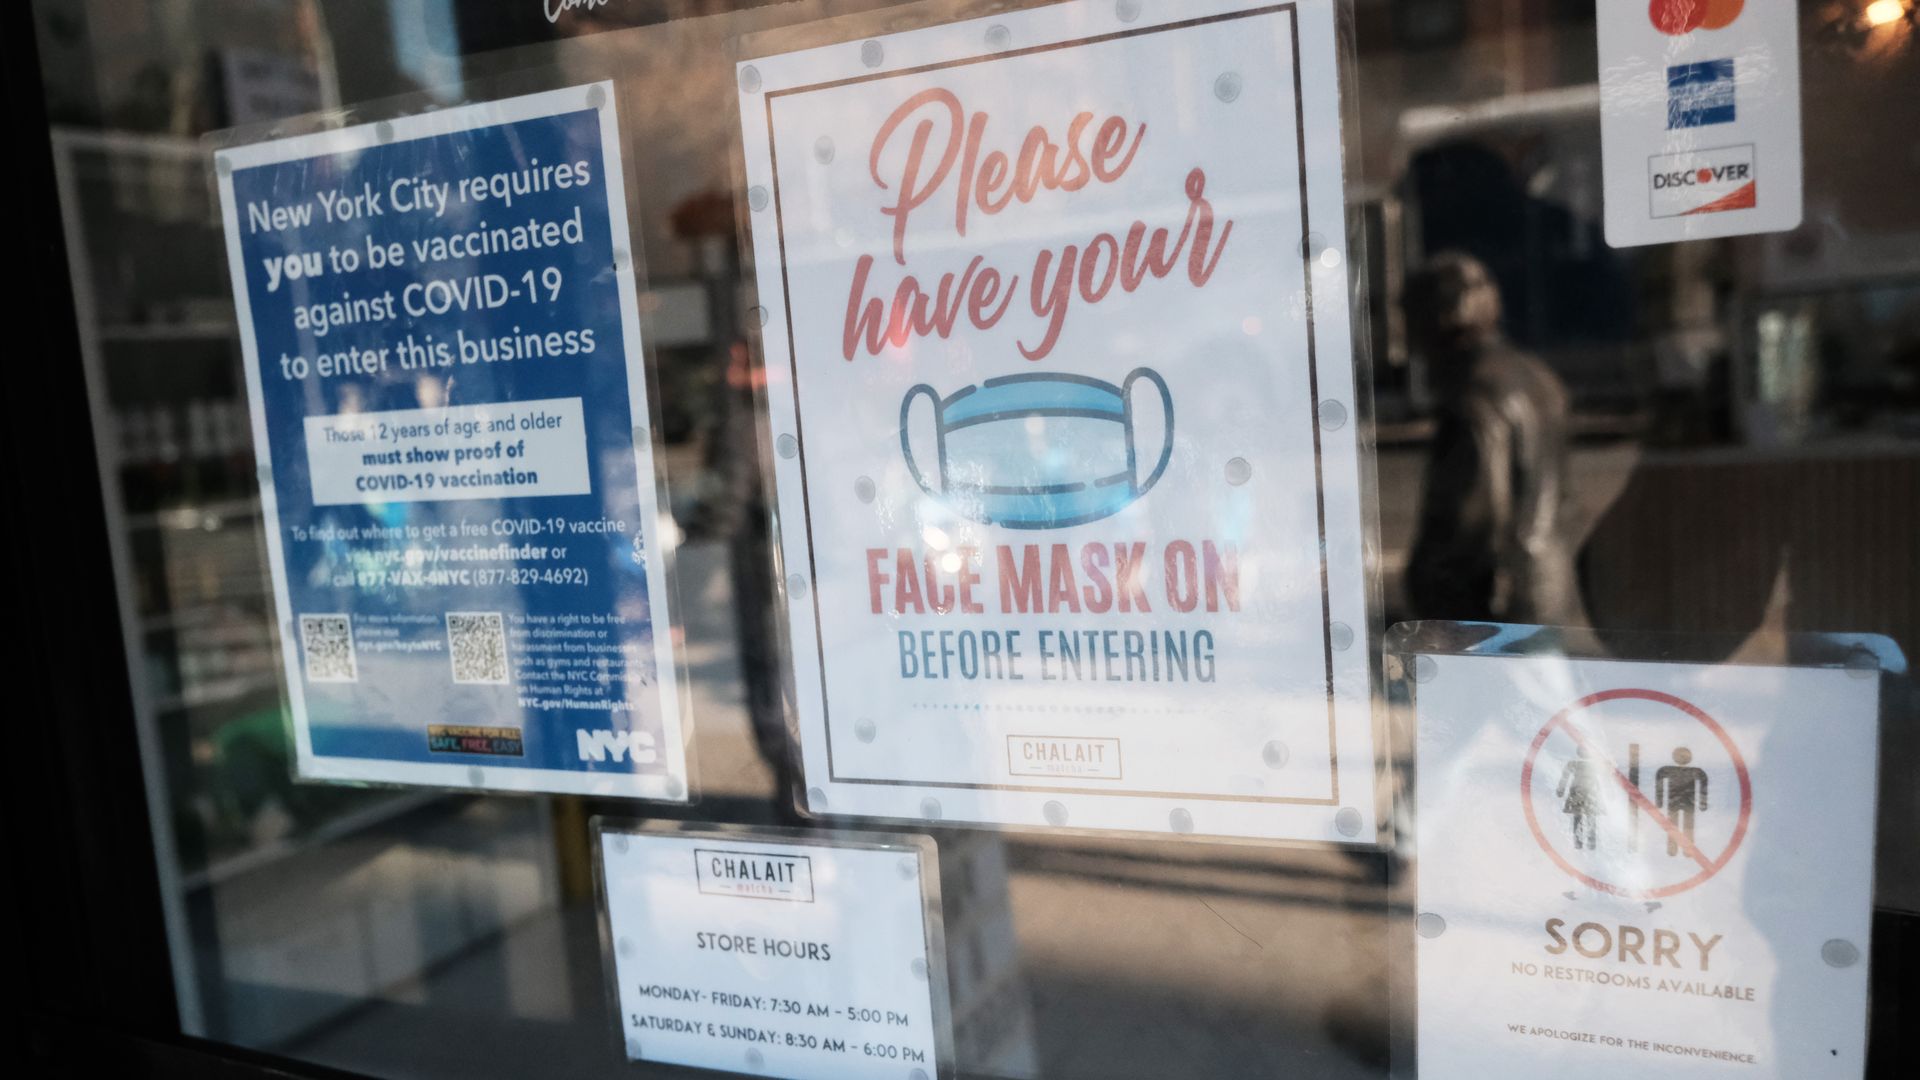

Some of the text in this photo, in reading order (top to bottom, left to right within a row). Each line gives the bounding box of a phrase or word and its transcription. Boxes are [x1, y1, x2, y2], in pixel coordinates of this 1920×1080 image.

[869, 87, 1146, 265] Please
[1653, 163, 1750, 189] DISCOVER
[248, 157, 591, 234] New York City requires
[263, 205, 583, 293] you to be vaccinated
[842, 167, 1234, 361] have your
[294, 266, 563, 337] against COVID-19
[280, 325, 596, 381] to enter this business
[323, 426, 365, 442] Those
[391, 424, 431, 443] years
[434, 417, 449, 436] of
[454, 421, 481, 439] age
[487, 413, 516, 432] and
[520, 411, 562, 430] older
[362, 439, 525, 466] must show proof of
[356, 466, 538, 491] COVID-19 vaccination
[292, 517, 626, 542] To find out where to get a free COVID-19 vaccine
[551, 548, 567, 559] or
[333, 571, 355, 587] call
[472, 567, 588, 588] (877-829-4692)
[866, 539, 1242, 615] FACE MASK ON
[508, 614, 525, 624] You
[526, 614, 548, 624] have
[557, 613, 579, 626] right
[580, 614, 590, 624] to
[592, 613, 605, 624] be
[607, 613, 626, 625] free
[597, 629, 608, 639] or
[563, 641, 586, 653] from
[898, 628, 1217, 683] BEFORE ENTERING
[567, 670, 589, 681] NYC
[576, 728, 657, 763] NYC
[1023, 742, 1105, 762] CHALAIT
[712, 857, 795, 883] CHALAIT
[696, 932, 831, 962] STORE HOURS
[1543, 917, 1723, 972] SORRY
[1511, 961, 1755, 1002] NO RESTROOMS AVAILABLE
[639, 985, 707, 1002] MONDAY-
[712, 991, 766, 1011] FRIDAY:
[770, 998, 801, 1014] 7:30
[807, 1003, 829, 1017] AM
[847, 1007, 881, 1023] 5:00
[886, 1011, 909, 1027] PM
[631, 1014, 702, 1034] SATURDAY
[707, 1022, 716, 1037] &
[720, 1024, 782, 1045] SUNDAY:
[785, 1032, 817, 1049] 8:30
[823, 1038, 846, 1052] AM
[864, 1042, 897, 1059] 6:00
[903, 1047, 925, 1063] PM
[1507, 1023, 1757, 1065] WE APOLOGIZE FOR THE INCONVENIENCE.
